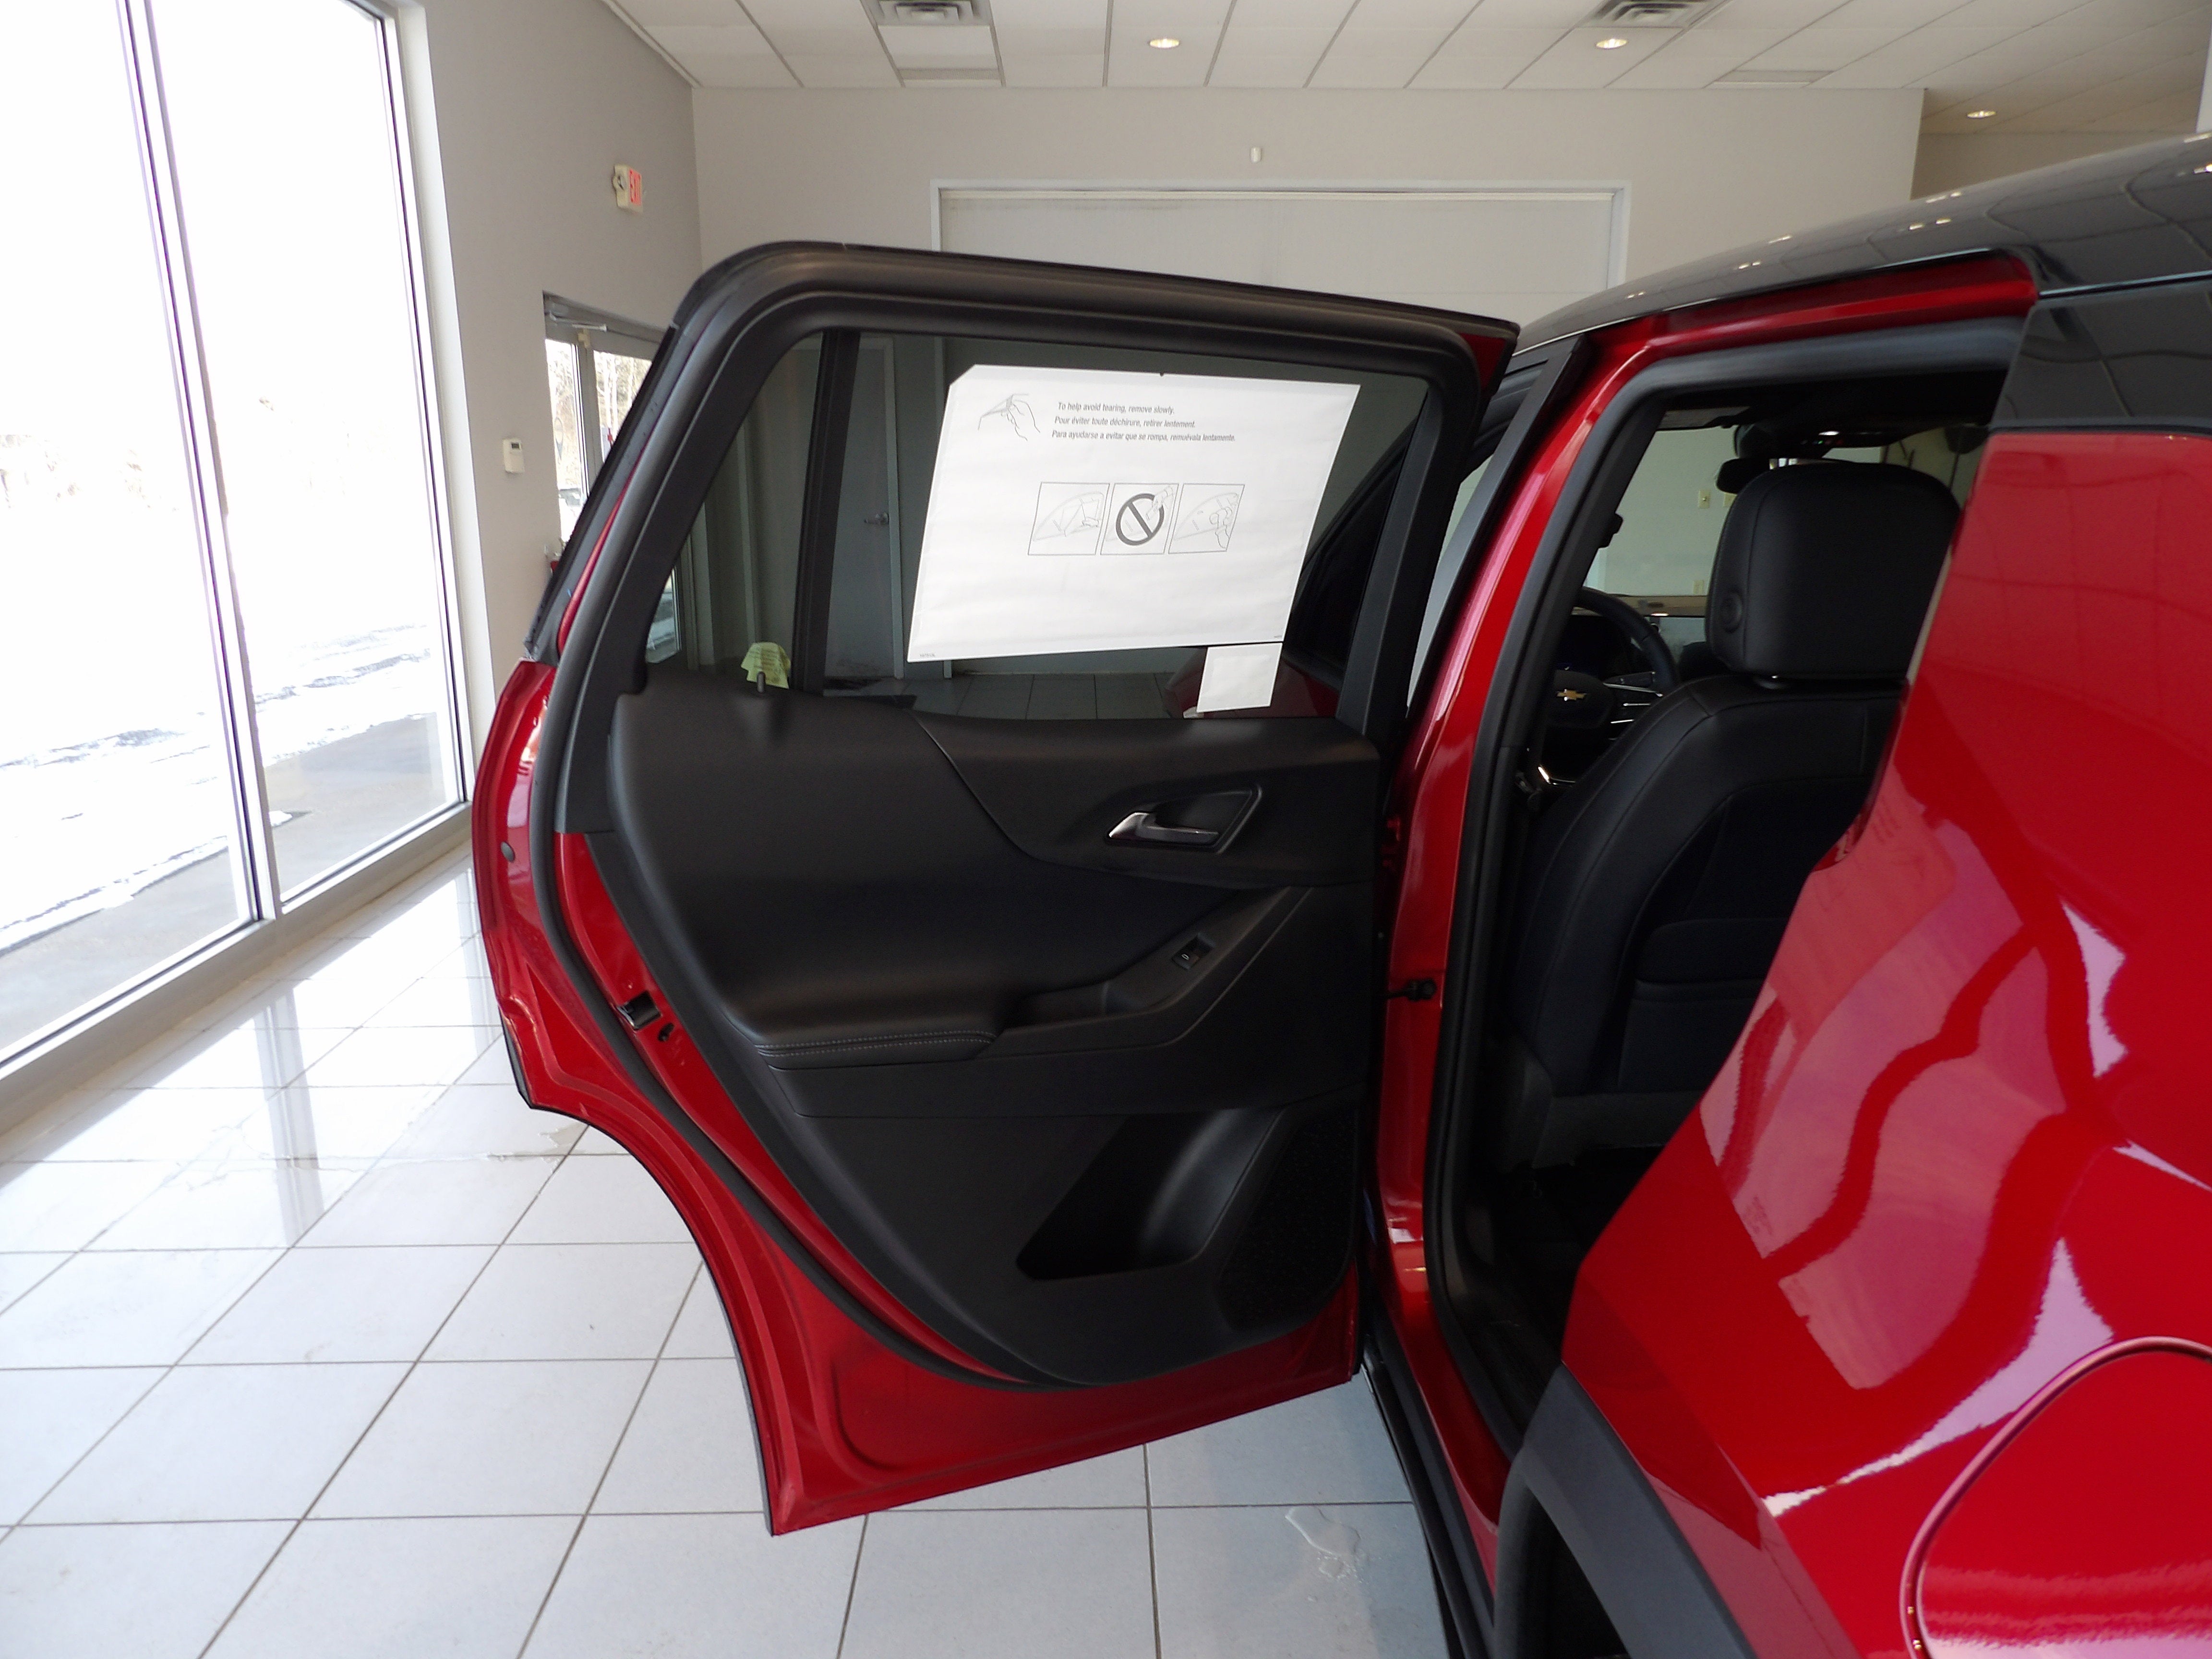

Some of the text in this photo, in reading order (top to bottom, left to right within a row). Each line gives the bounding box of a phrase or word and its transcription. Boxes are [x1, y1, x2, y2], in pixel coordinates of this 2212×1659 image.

[1058, 402, 1066, 410] To
[1068, 402, 1082, 412] help
[1103, 404, 1126, 413] tearing,
[1055, 416, 1069, 424] Pour
[1052, 430, 1067, 438] Para
[1069, 431, 1098, 439] ayudarse
